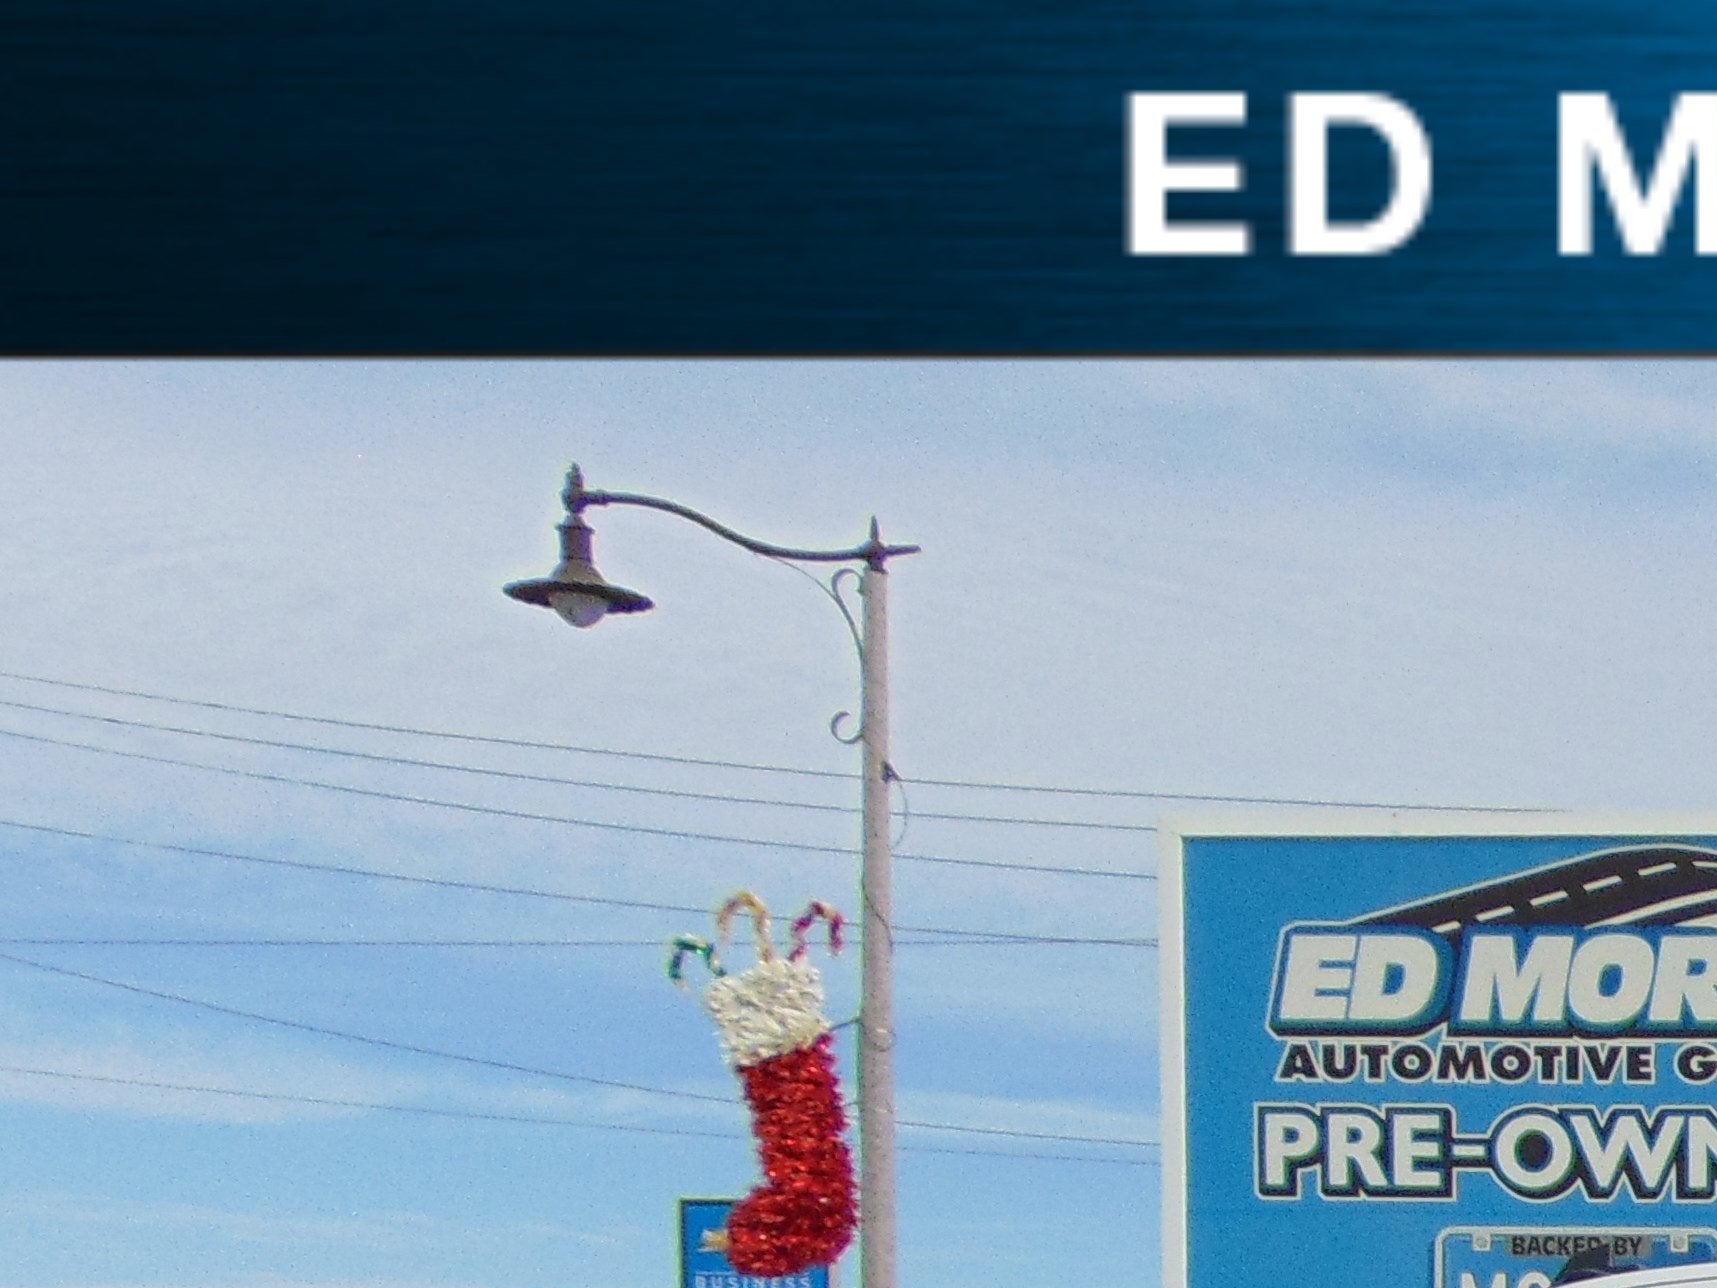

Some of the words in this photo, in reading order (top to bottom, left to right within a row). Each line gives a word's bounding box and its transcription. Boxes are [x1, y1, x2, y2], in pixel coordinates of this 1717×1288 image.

[1279, 934, 1439, 1021] ED
[1279, 1043, 1656, 1082] AUTOMOTIVE
[1614, 1235, 1641, 1256] BY
